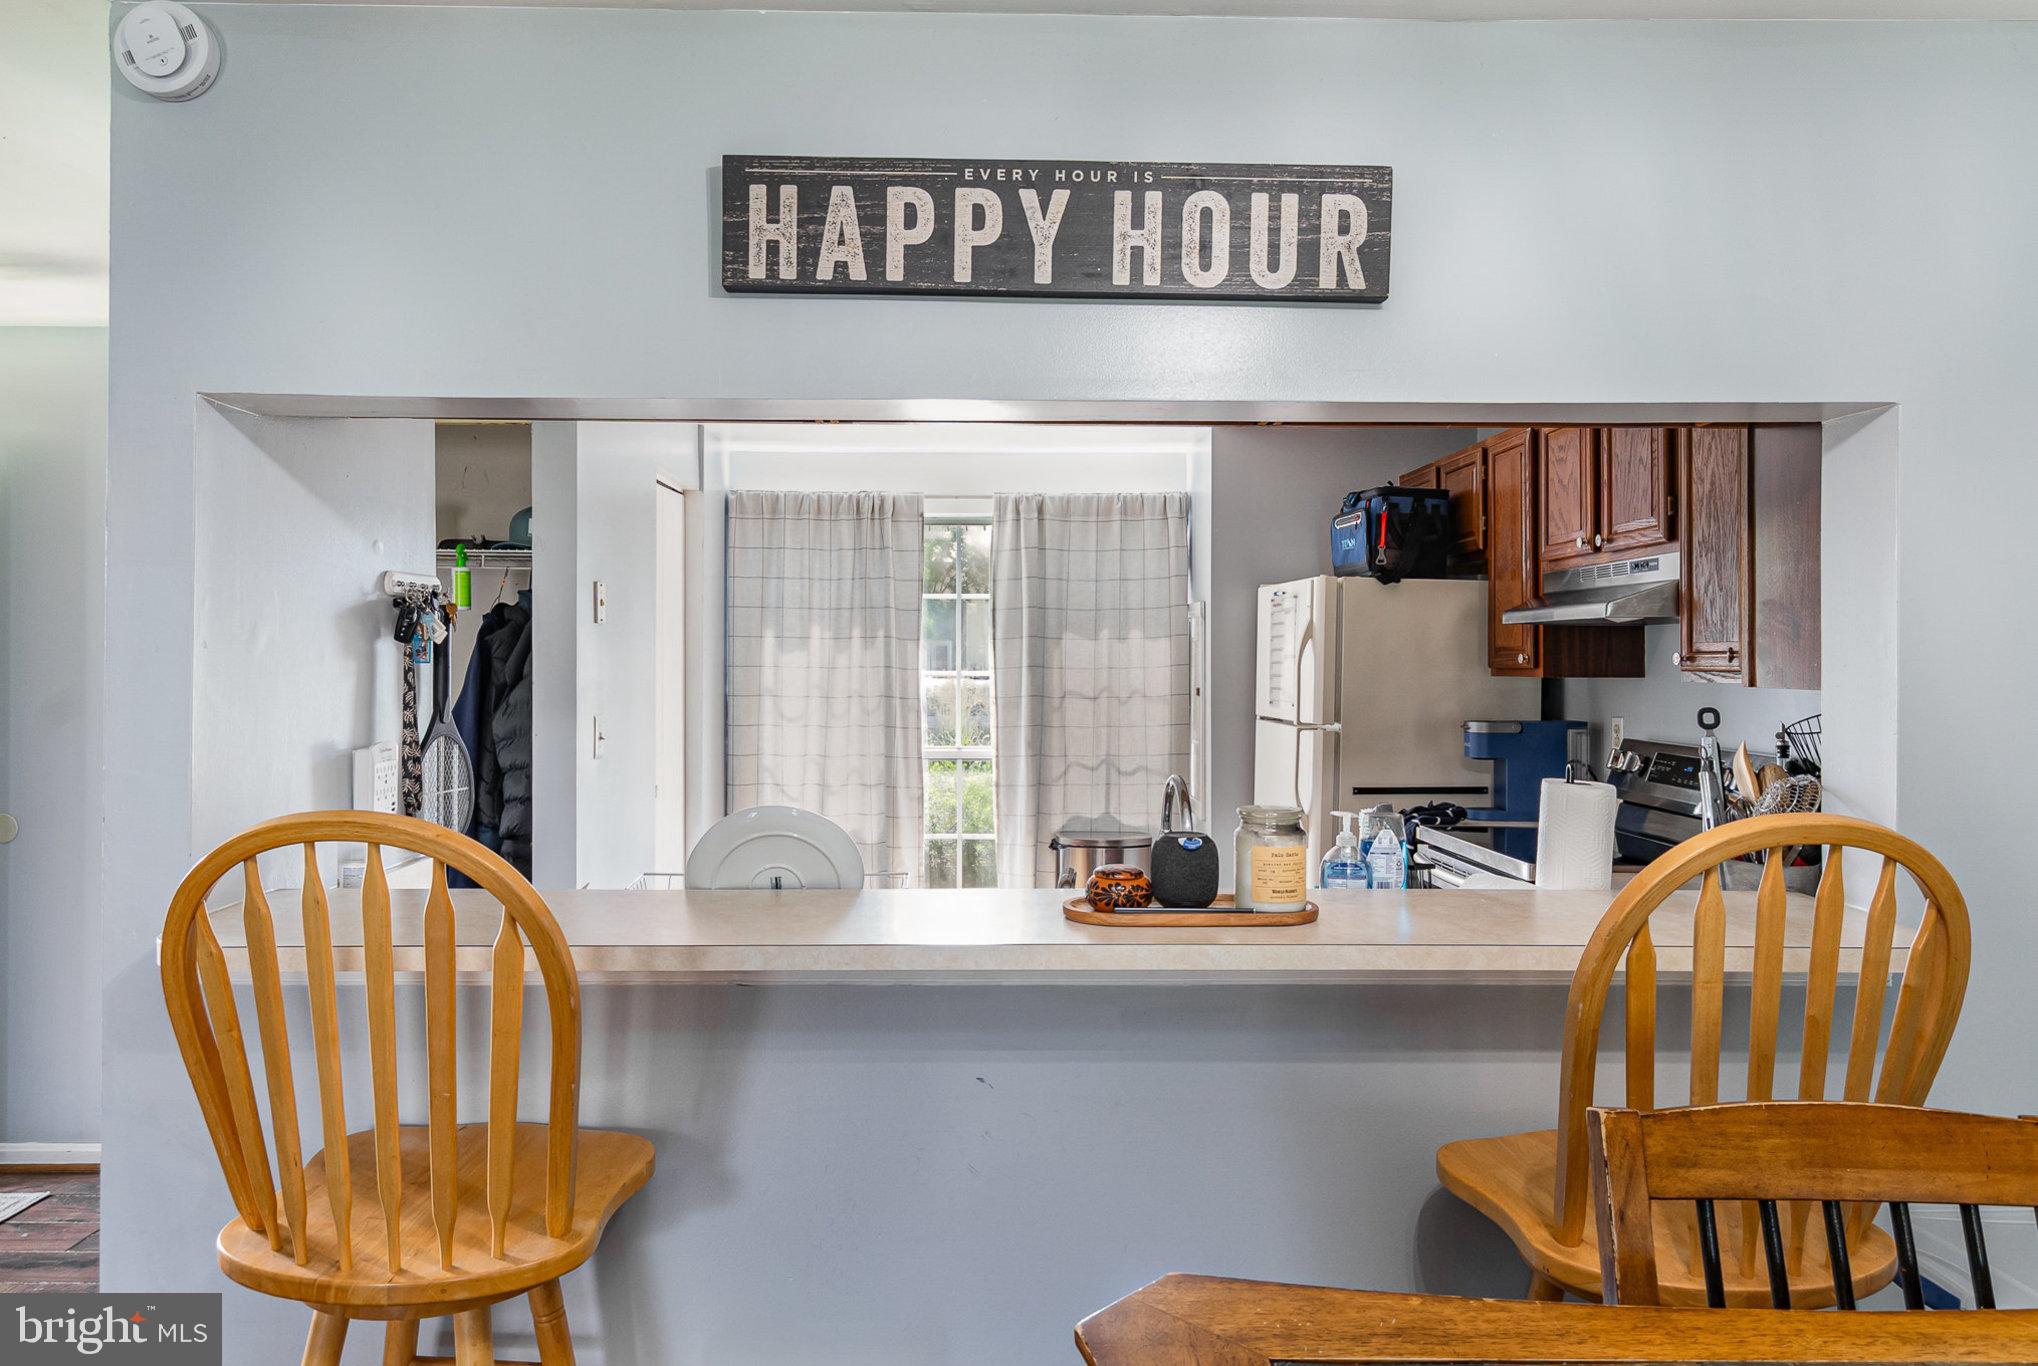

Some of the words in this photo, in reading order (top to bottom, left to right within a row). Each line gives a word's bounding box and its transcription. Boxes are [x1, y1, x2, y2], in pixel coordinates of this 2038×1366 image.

[964, 167, 1041, 182] EVERY
[1055, 169, 1118, 183] HOUR
[1133, 170, 1154, 183] IS
[747, 182, 1071, 285] HAPPY
[1111, 189, 1370, 291] HOUR
